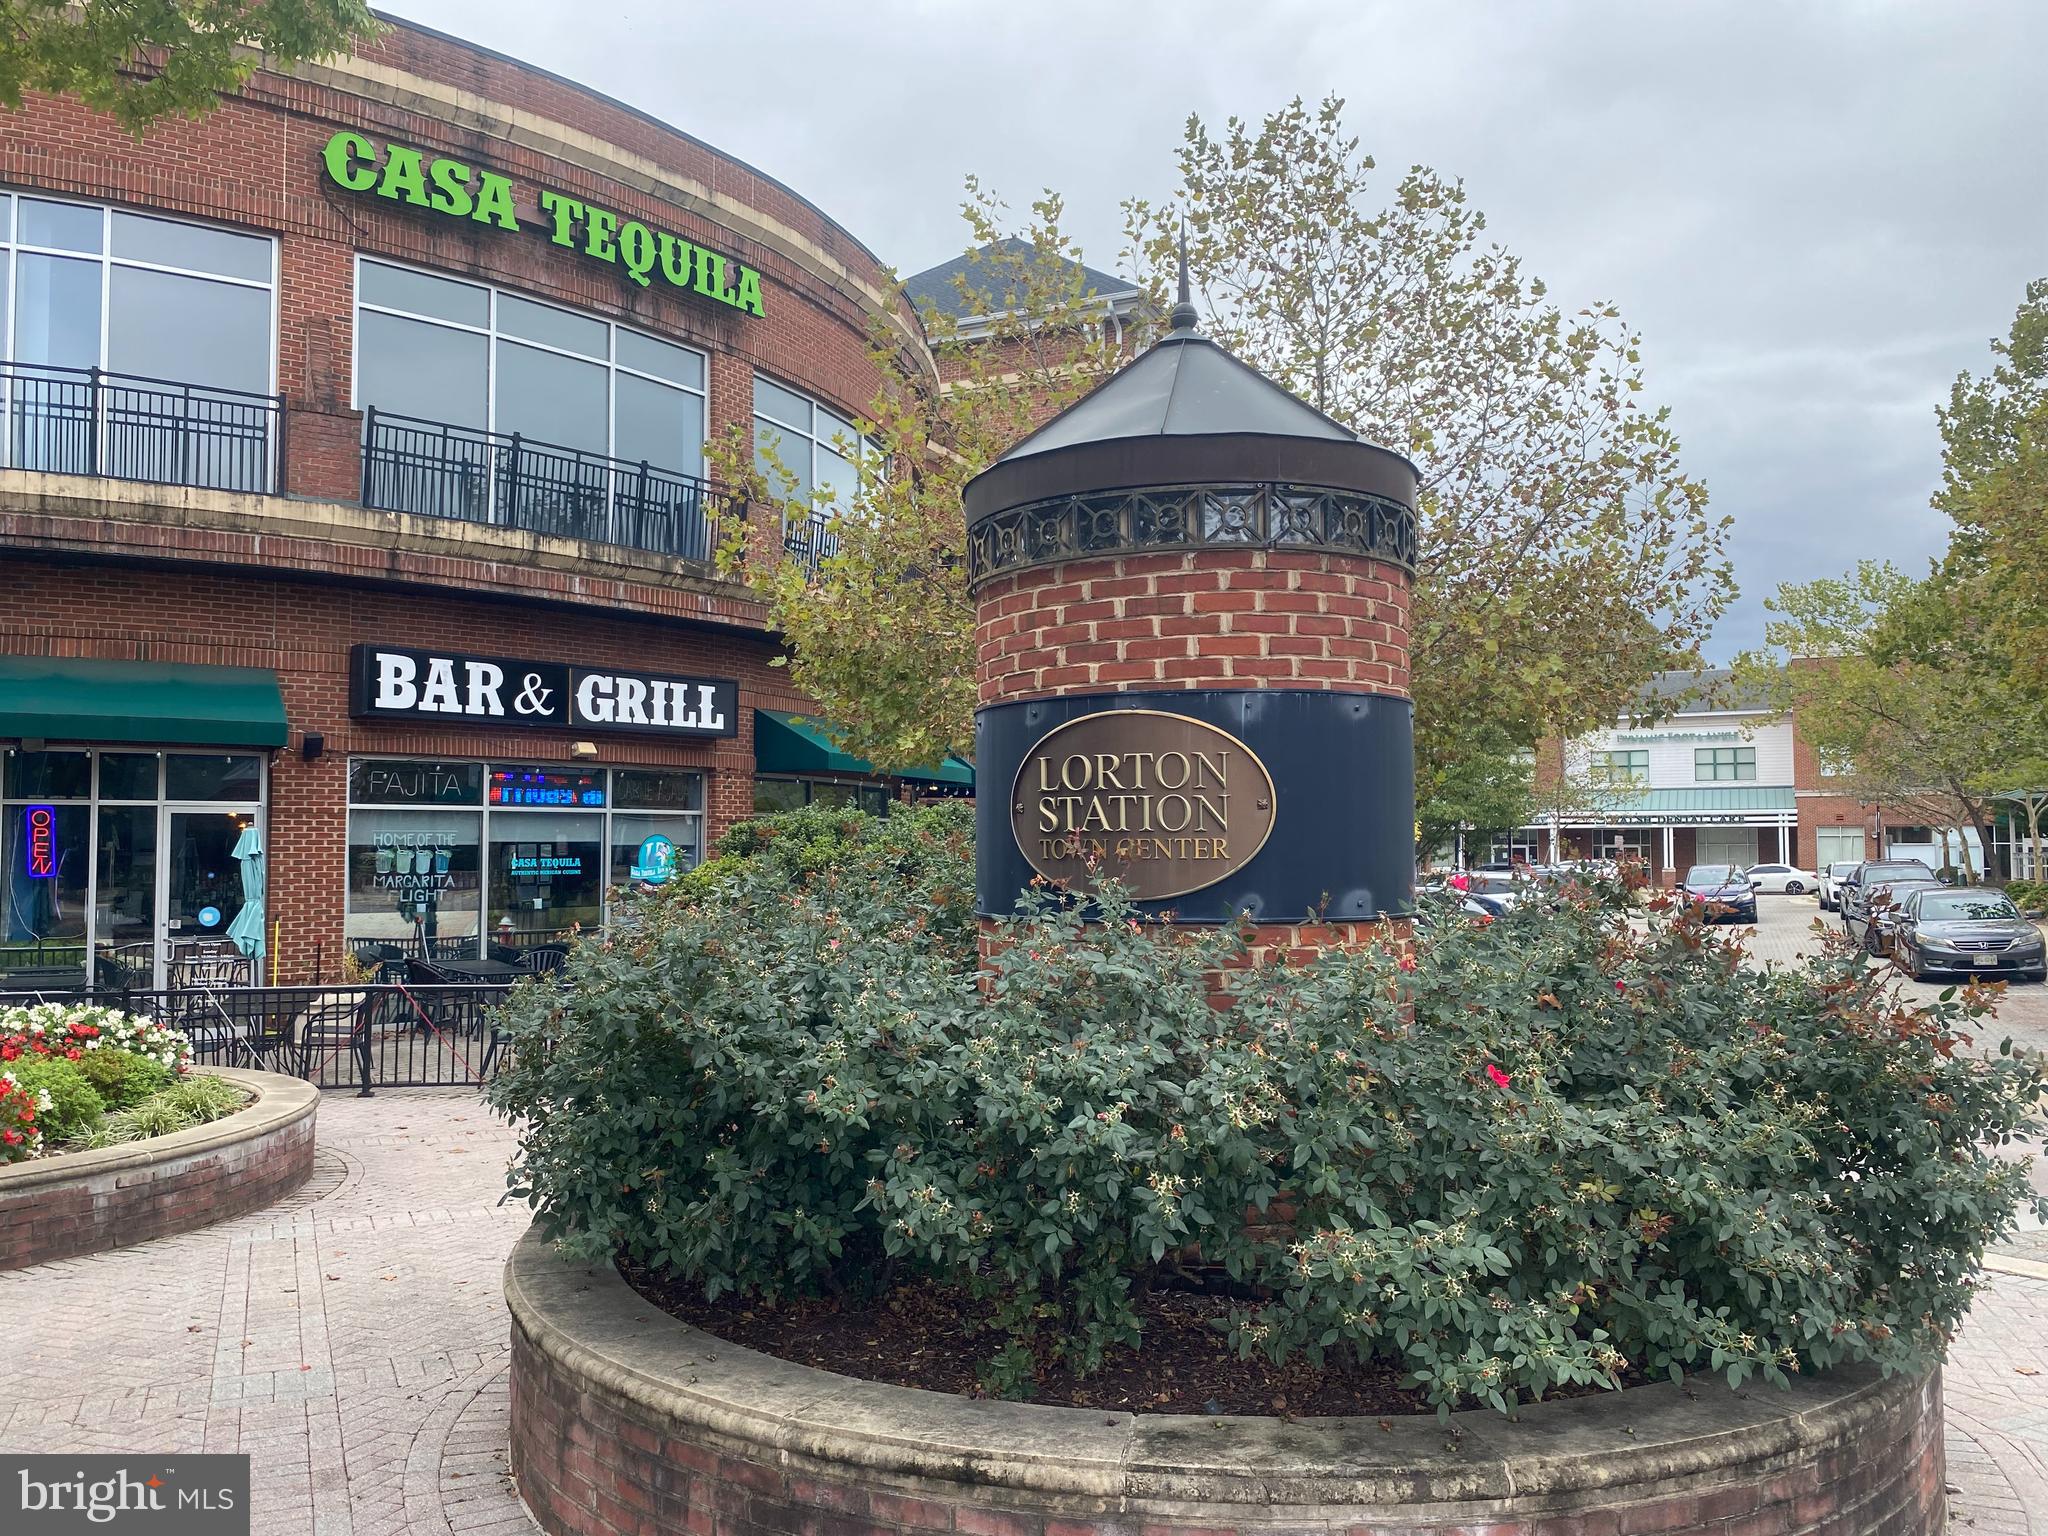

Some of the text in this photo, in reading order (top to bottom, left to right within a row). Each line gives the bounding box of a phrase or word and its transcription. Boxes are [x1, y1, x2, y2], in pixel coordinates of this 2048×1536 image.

[320, 131, 767, 318] CASA TEQUILA
[375, 652, 725, 730] BAR & GRILL
[370, 770, 461, 796] FAJITA
[1037, 751, 1231, 791] LORTON
[1038, 794, 1231, 833] STATION
[1657, 815, 1706, 825] DENTAL
[1710, 815, 1745, 824] CARE
[31, 810, 52, 874] OPEN
[373, 833, 457, 846] HOME OF THE
[511, 857, 581, 868] CASA TEQUILA
[373, 875, 455, 888] MARGARITA
[388, 889, 448, 902] FLIGHT
